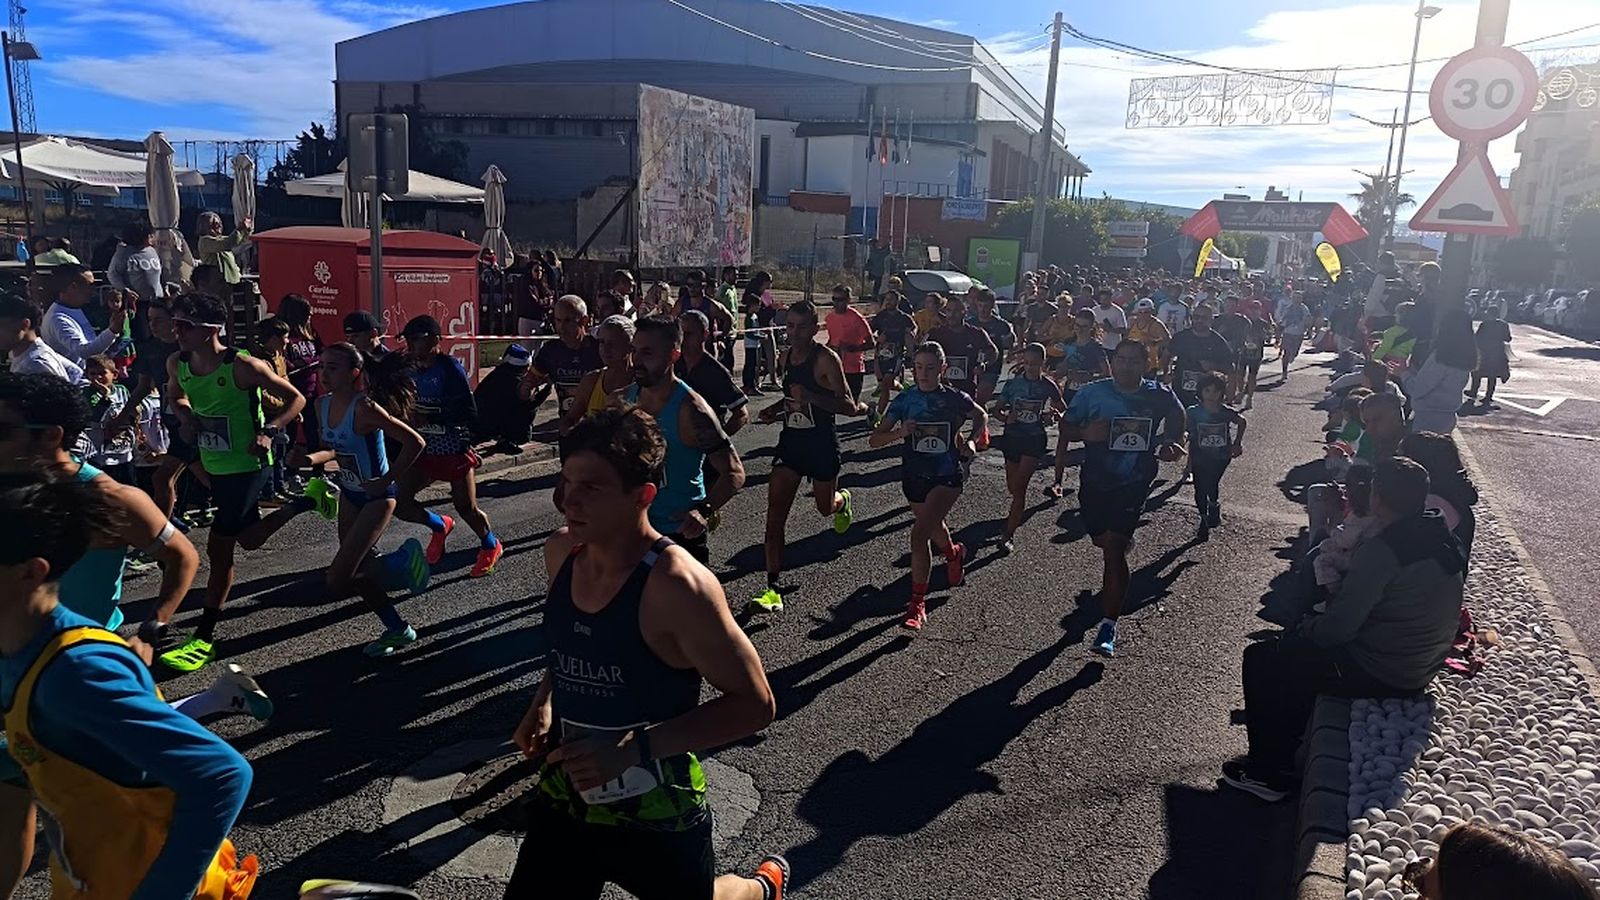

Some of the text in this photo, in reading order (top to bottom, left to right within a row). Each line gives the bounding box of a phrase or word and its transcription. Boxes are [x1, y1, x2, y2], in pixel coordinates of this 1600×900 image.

[1452, 78, 1514, 110] 30
[924, 438, 938, 449] 10
[1122, 434, 1138, 446] 43
